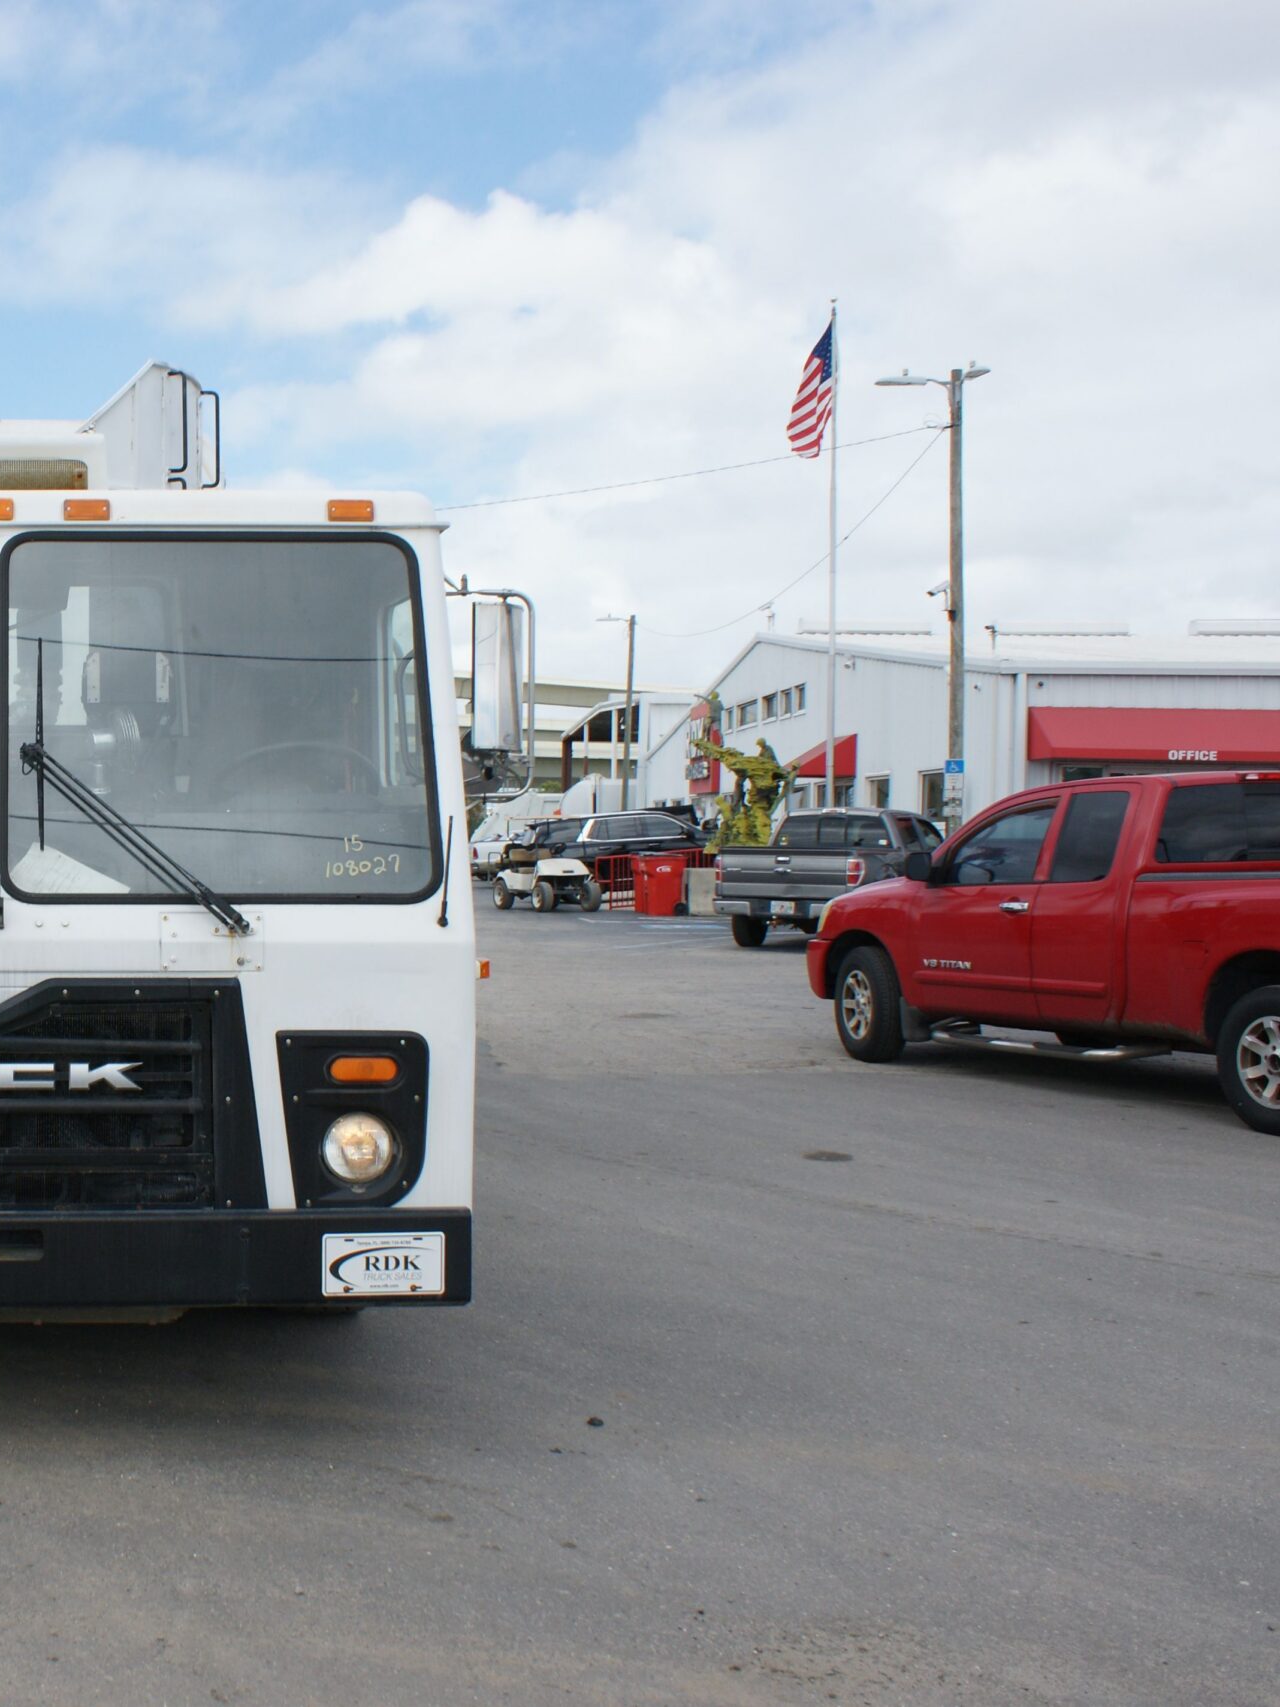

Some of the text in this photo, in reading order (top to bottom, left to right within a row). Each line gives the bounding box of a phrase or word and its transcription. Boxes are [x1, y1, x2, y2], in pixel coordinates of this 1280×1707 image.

[1168, 750, 1218, 761] OFFICE
[344, 834, 364, 853] 15
[325, 854, 401, 878] 108027
[939, 959, 972, 970] TITAN
[364, 1255, 421, 1271] RDK
[363, 1271, 422, 1281] TRUCK SALES
